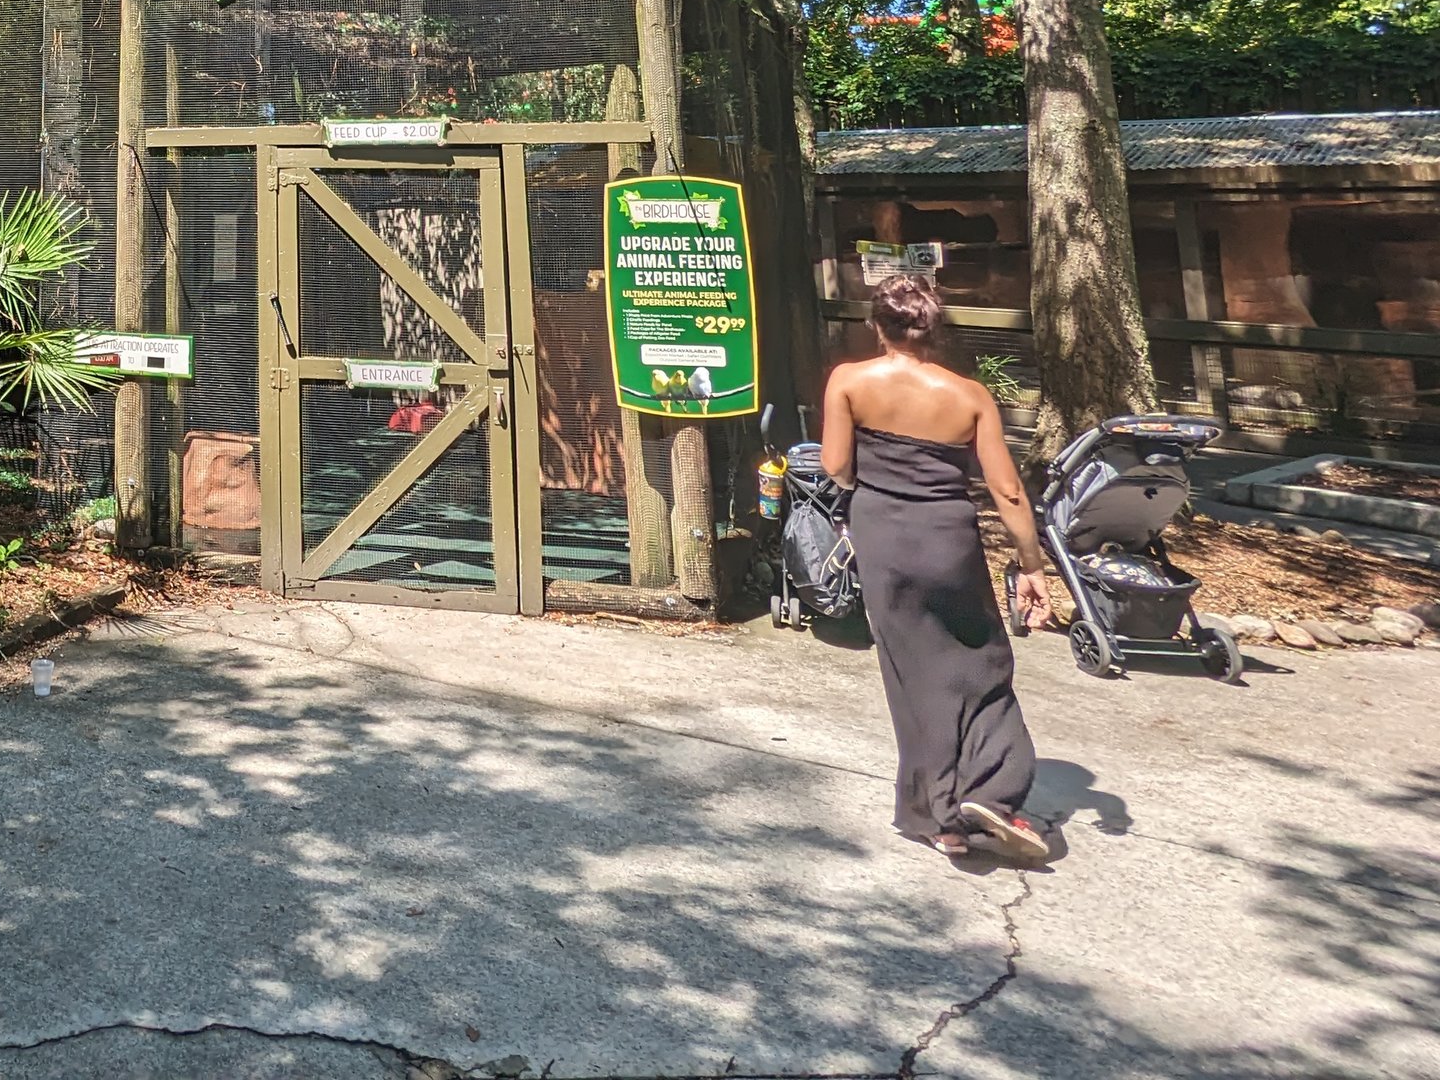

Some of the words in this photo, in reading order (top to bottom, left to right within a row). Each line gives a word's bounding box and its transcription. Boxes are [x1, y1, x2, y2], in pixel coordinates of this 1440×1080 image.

[334, 127, 360, 138] FEED
[366, 126, 387, 138] CUP
[403, 125, 437, 137] $2.00
[643, 204, 711, 219] BIRDHOUSE
[620, 236, 691, 251] UPGRADE
[694, 236, 735, 252] YOUR
[617, 253, 676, 269] ANIMAL
[679, 254, 742, 270] FEEDING
[635, 271, 726, 287] EXPERIENCE
[622, 290, 663, 299] ULTIMATE
[664, 291, 698, 299] ANIMAL
[699, 292, 737, 300] FEEDING
[633, 298, 685, 307] EXPERIENCE
[687, 299, 727, 307] PACKAGE
[100, 340, 142, 352] ATTRACTION
[144, 342, 179, 354] OPERATES
[362, 368, 422, 382] ENTRANCE
